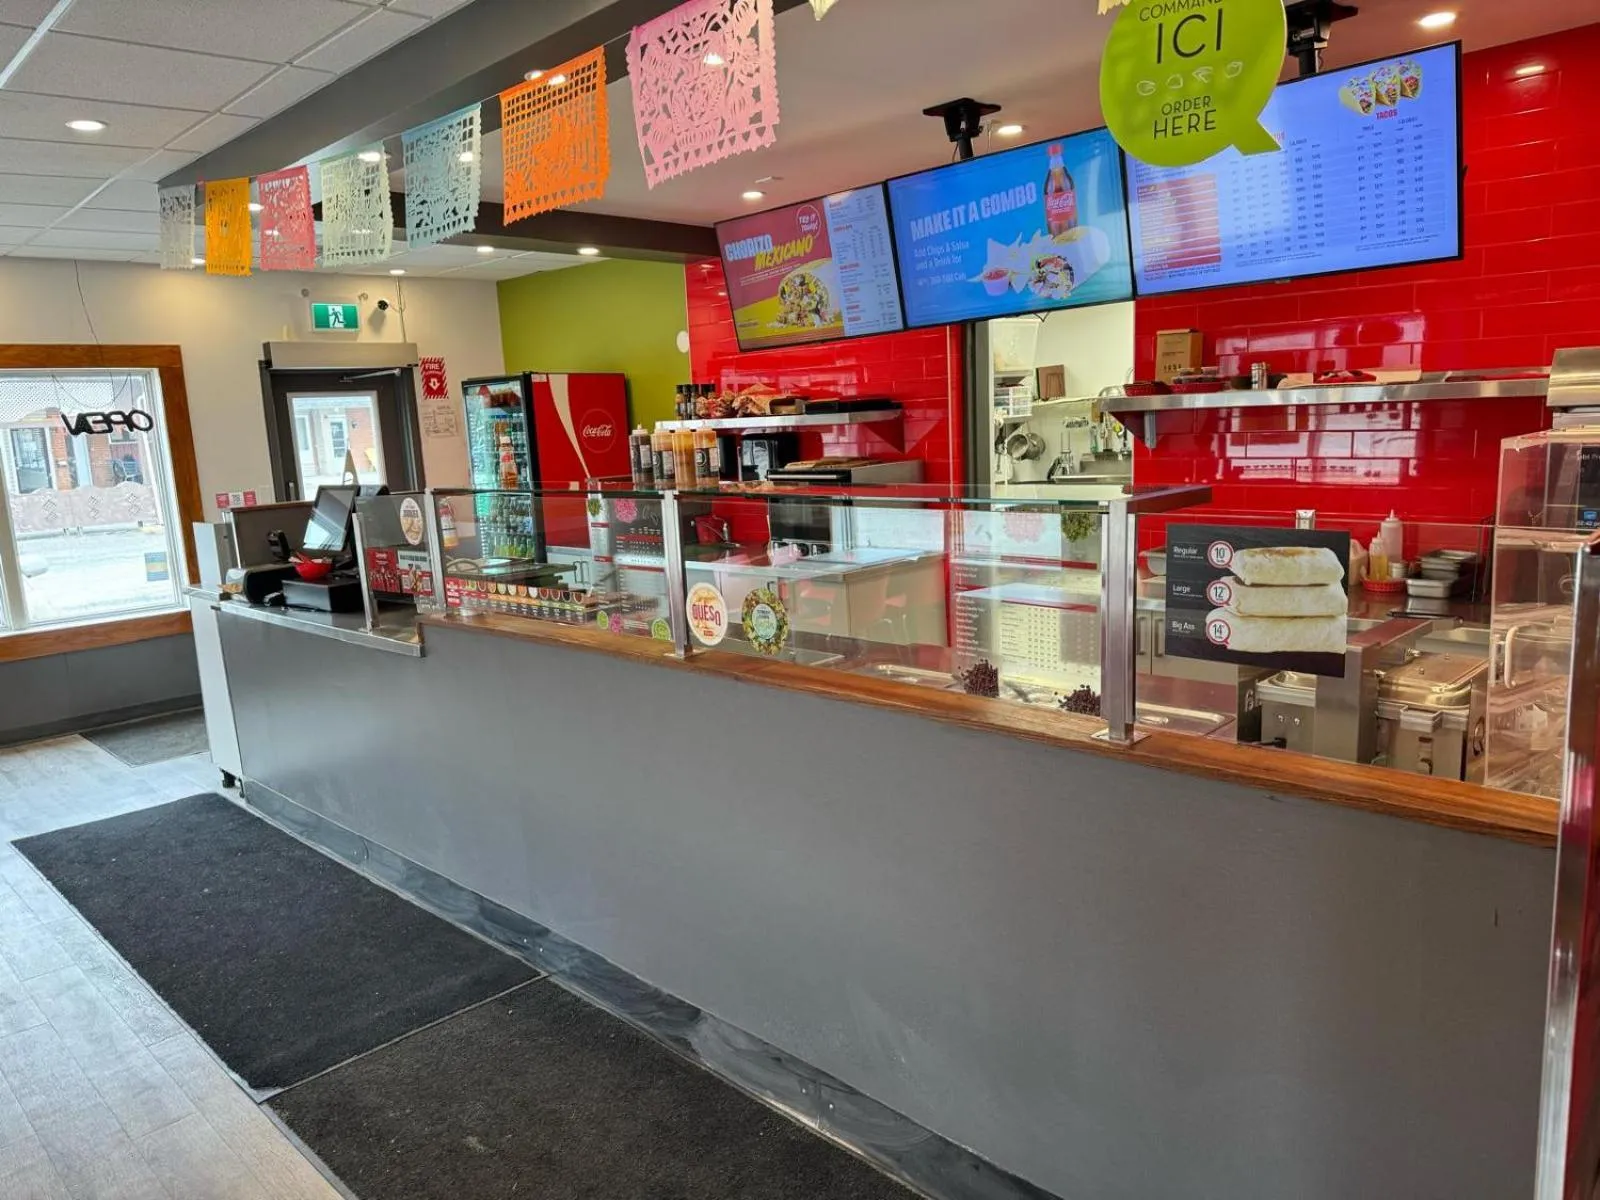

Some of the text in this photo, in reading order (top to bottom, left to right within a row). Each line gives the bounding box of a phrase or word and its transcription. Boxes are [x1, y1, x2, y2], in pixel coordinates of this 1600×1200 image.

[1156, 8, 1223, 64] ICI
[1161, 95, 1212, 116] ORDER
[1376, 109, 1398, 120] TACOS
[1153, 109, 1217, 140] HERE
[910, 181, 1037, 242] MAKE IT A COMBO
[754, 234, 814, 272] MEXICANO
[582, 424, 612, 438] Coca-Cola
[1173, 546, 1198, 555] Regular
[1172, 584, 1191, 593] Large
[692, 603, 721, 627] QUESO
[1171, 621, 1195, 630] Big Ass
